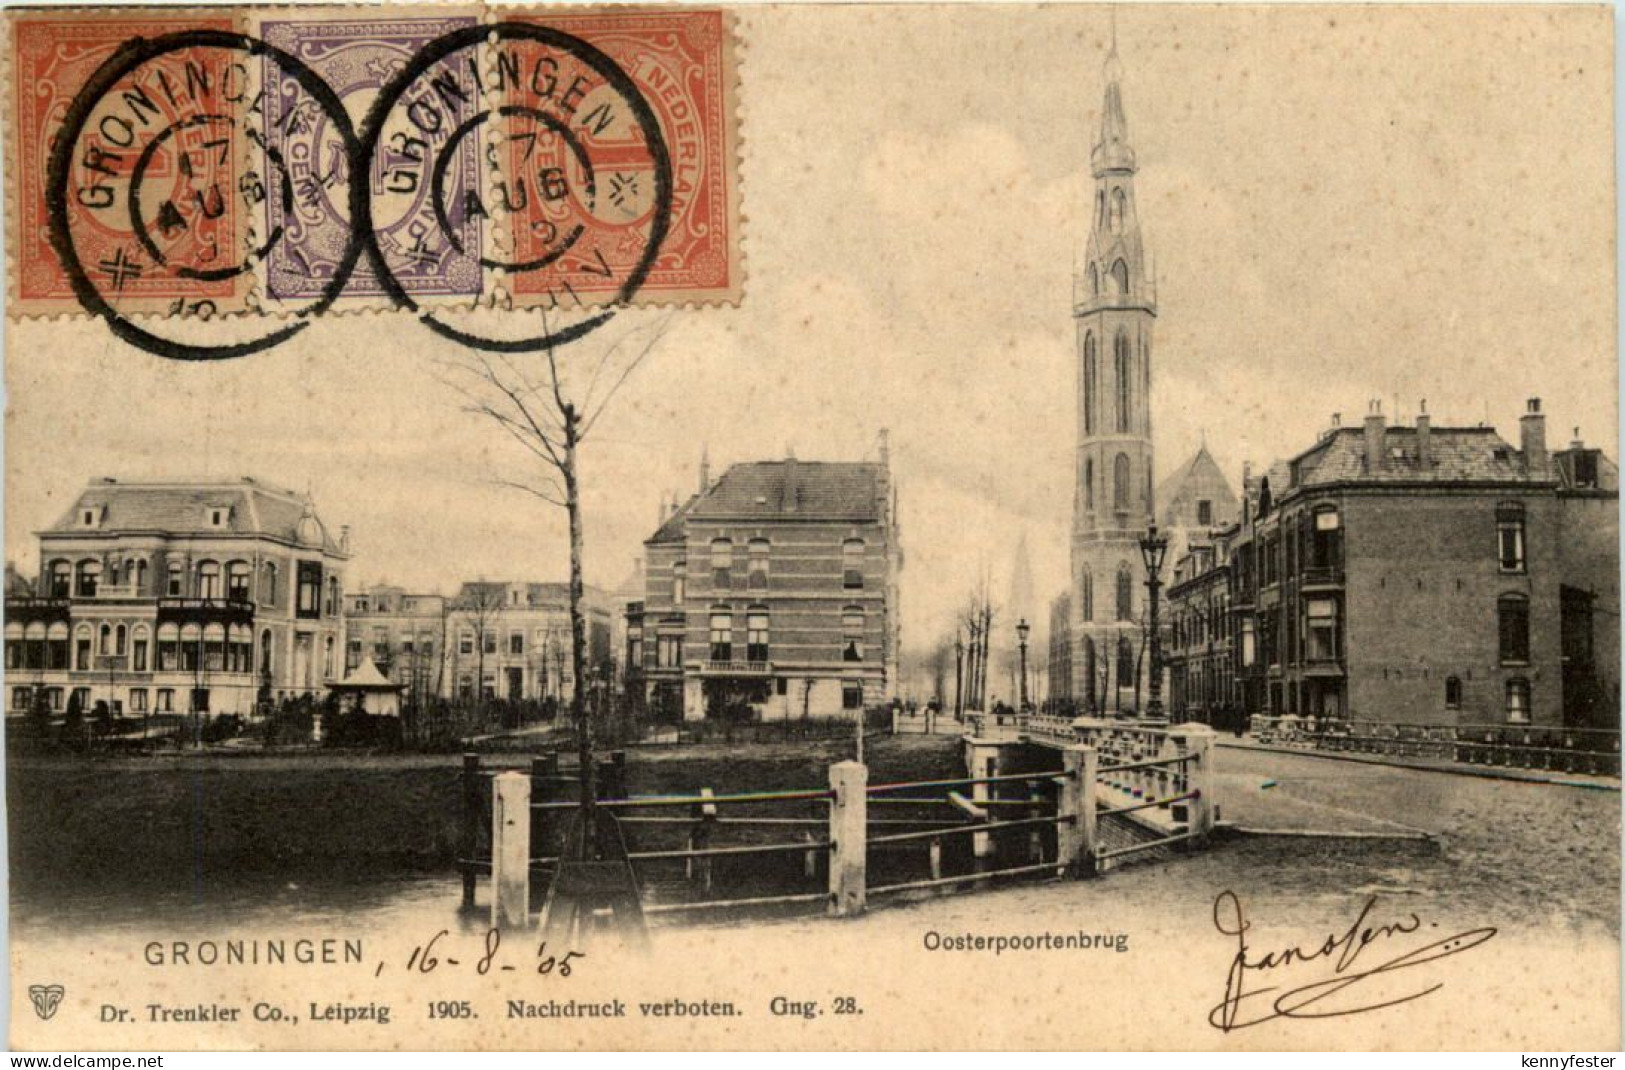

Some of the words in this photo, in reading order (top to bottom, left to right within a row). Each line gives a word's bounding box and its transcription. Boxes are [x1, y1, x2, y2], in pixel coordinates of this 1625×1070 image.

[382, 50, 616, 195] GRONINGEN
[646, 65, 697, 220] NEDERLAN
[144, 938, 364, 966] GRONINGEN
[923, 930, 1129, 954] Oosterpoortenbrug
[100, 1004, 135, 1023] Dr.
[146, 1003, 241, 1022] Trenkler
[252, 1002, 299, 1025] Co.,
[309, 1002, 390, 1025] Leipzig
[427, 1000, 479, 1020] 1905.
[506, 999, 626, 1019] Nachdruck
[639, 998, 743, 1018] verboten.
[769, 996, 824, 1021] Gng.
[832, 995, 864, 1016] 28.
